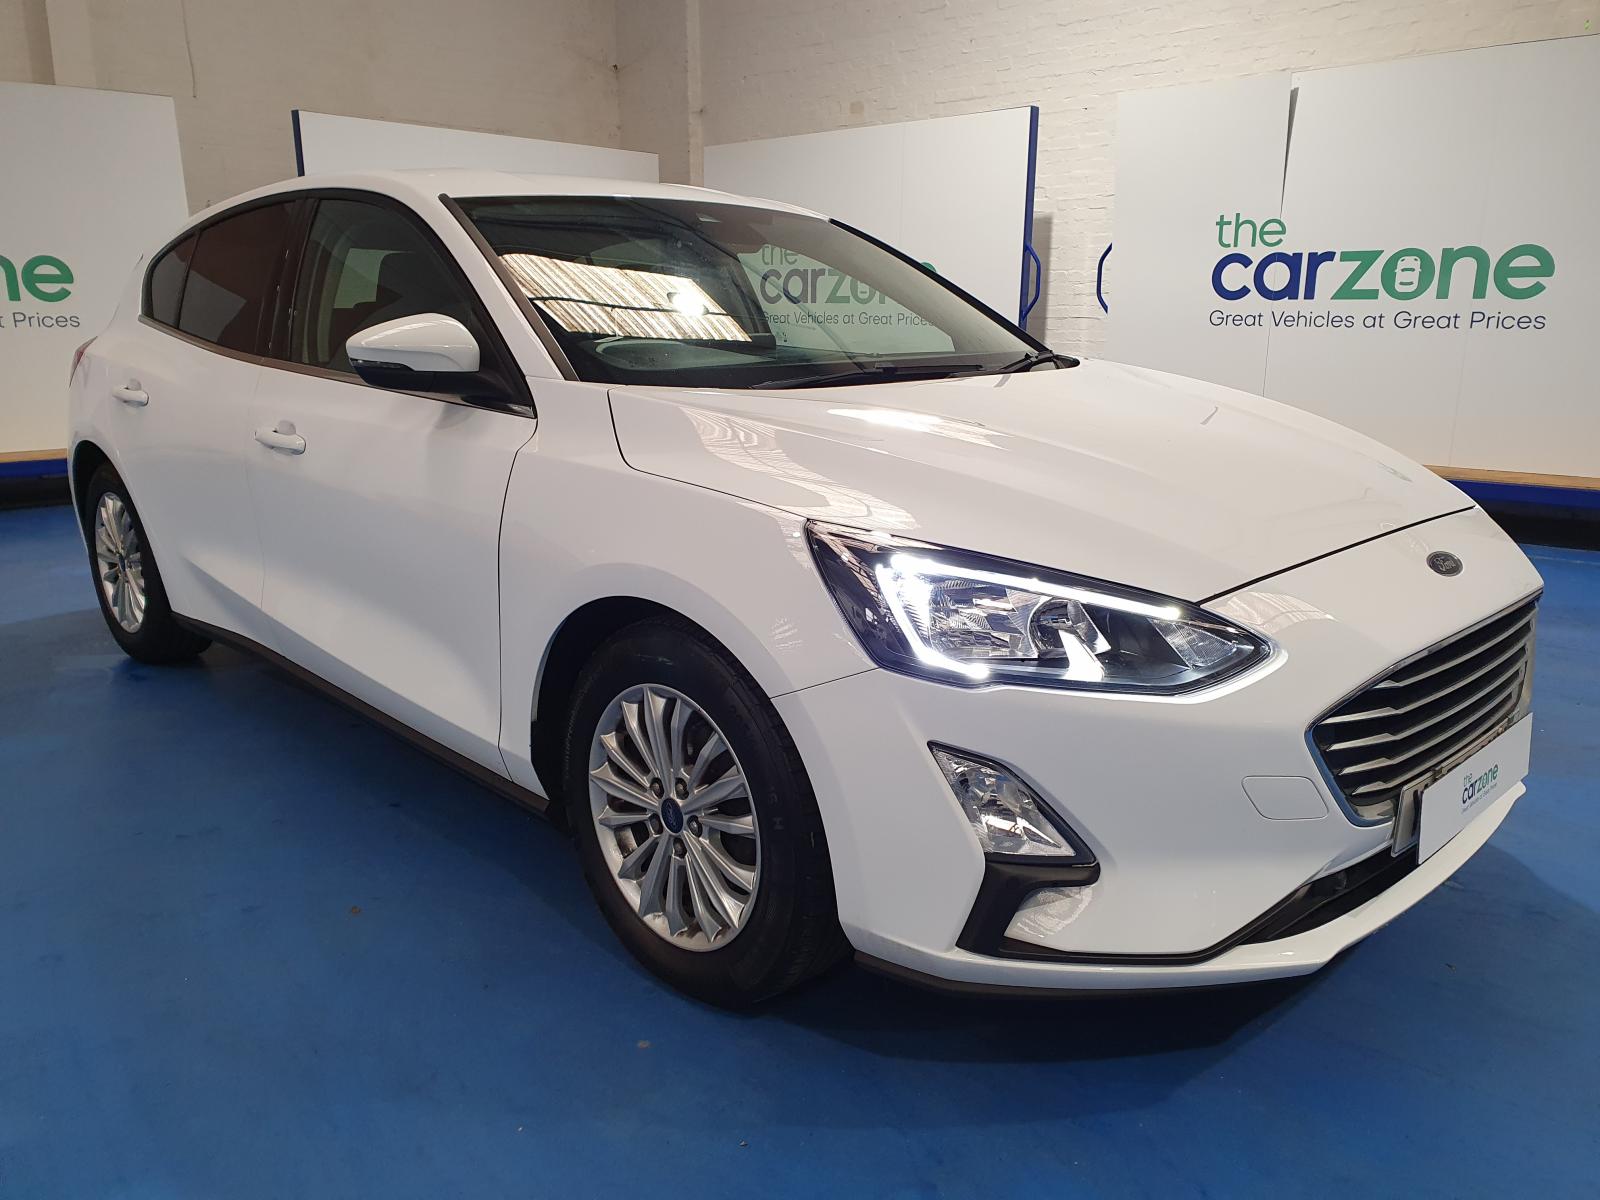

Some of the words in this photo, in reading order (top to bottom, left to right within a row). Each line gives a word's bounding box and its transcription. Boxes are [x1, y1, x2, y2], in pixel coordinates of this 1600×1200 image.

[1215, 212, 1287, 248] the
[1211, 243, 1556, 301] carzone
[12, 311, 81, 328] Prices
[794, 312, 839, 325] Vehicles
[842, 313, 855, 325] at
[858, 312, 893, 325] Great
[1209, 309, 1264, 327] Great
[1271, 310, 1355, 328] Vehicles
[1362, 313, 1386, 329] at
[1393, 310, 1461, 329] Great
[1469, 310, 1547, 330] Prices
[1462, 764, 1499, 804] carzone
